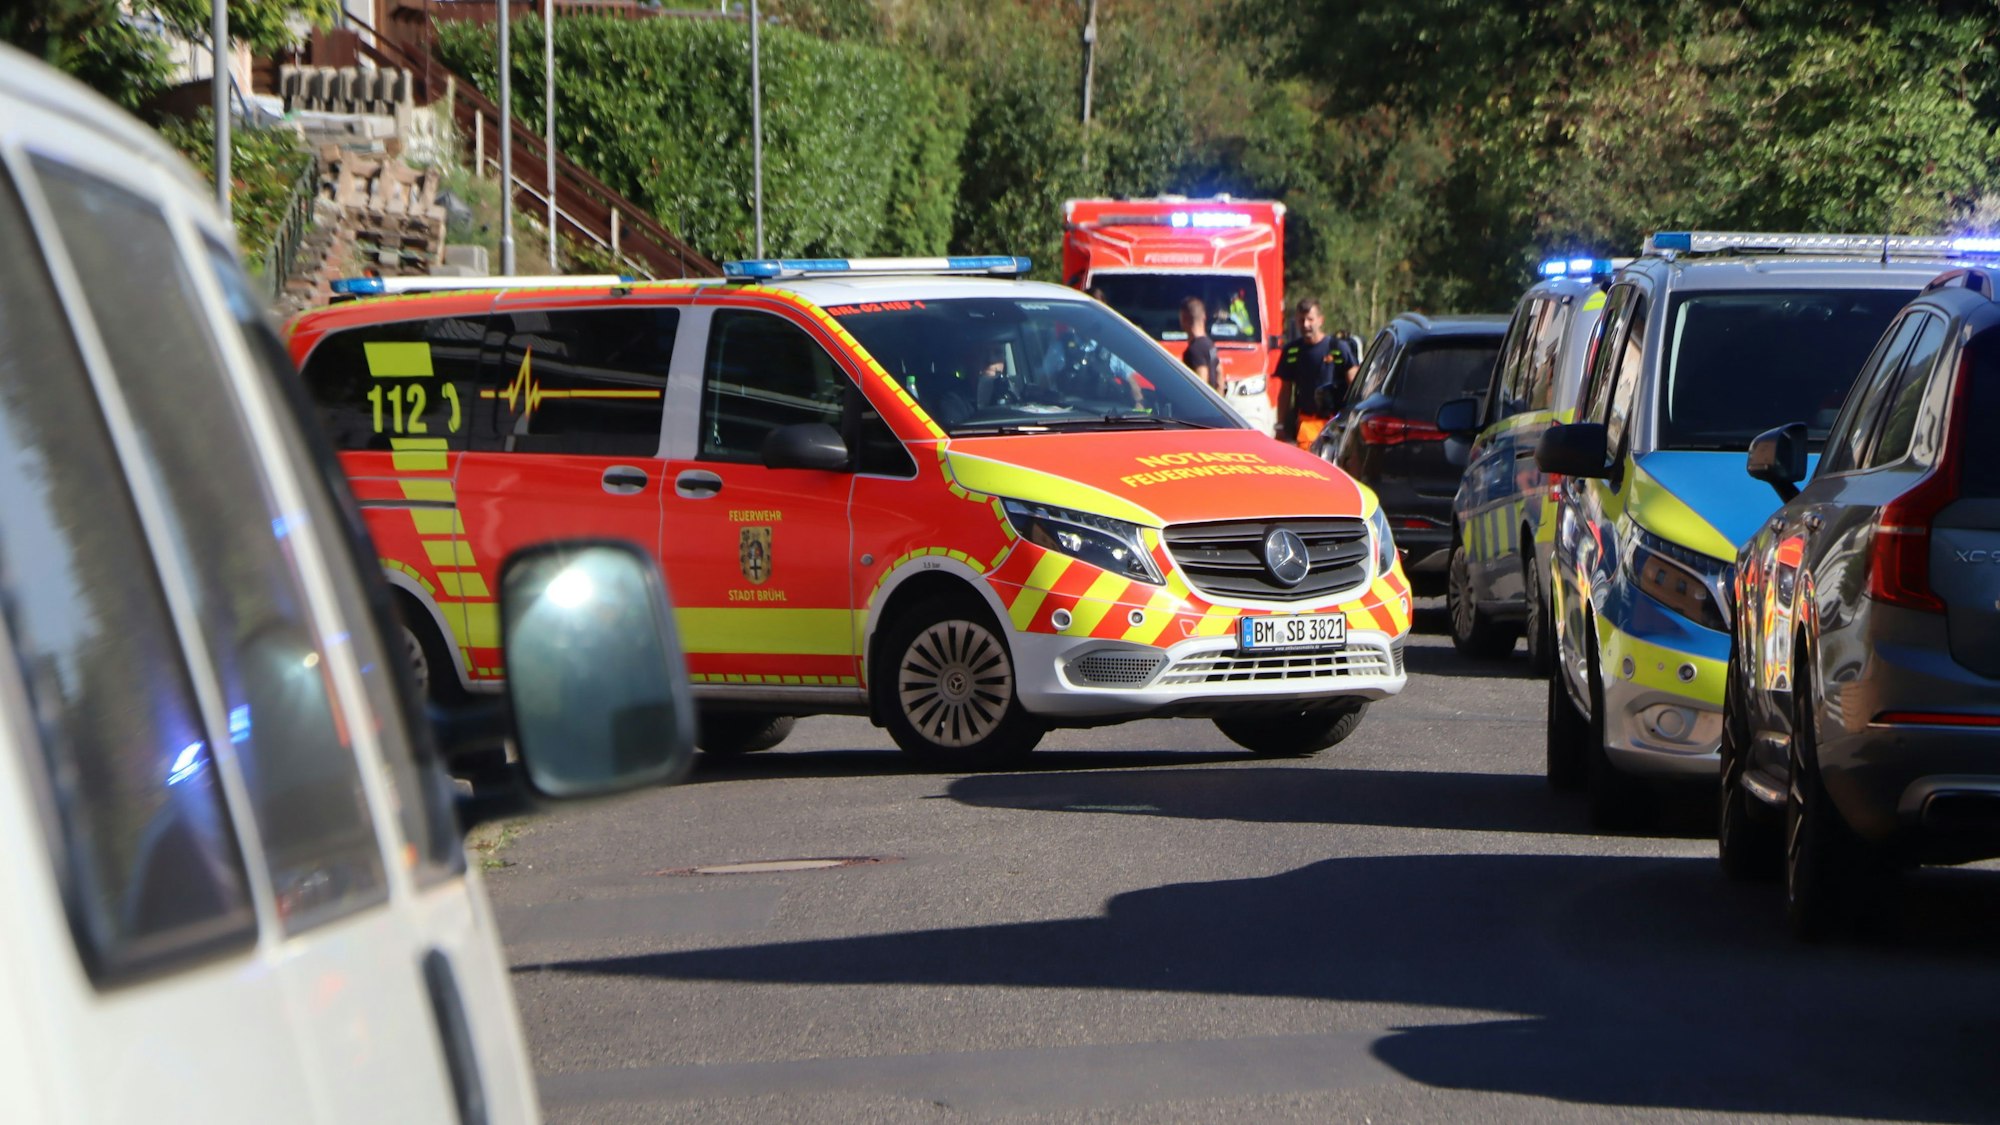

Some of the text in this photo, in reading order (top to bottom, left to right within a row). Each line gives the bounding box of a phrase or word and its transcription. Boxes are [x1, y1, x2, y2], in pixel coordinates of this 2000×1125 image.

[367, 384, 427, 433] 112
[1136, 452, 1267, 468] NOTARZT
[1120, 464, 1331, 488] FEUERWEHR BRÜHL
[728, 510, 783, 521] FEUERWEHR
[728, 588, 787, 601] STADT BRÜHL
[1254, 621, 1275, 643] BM
[1287, 620, 1305, 641] SB
[1310, 618, 1343, 640] 3821
